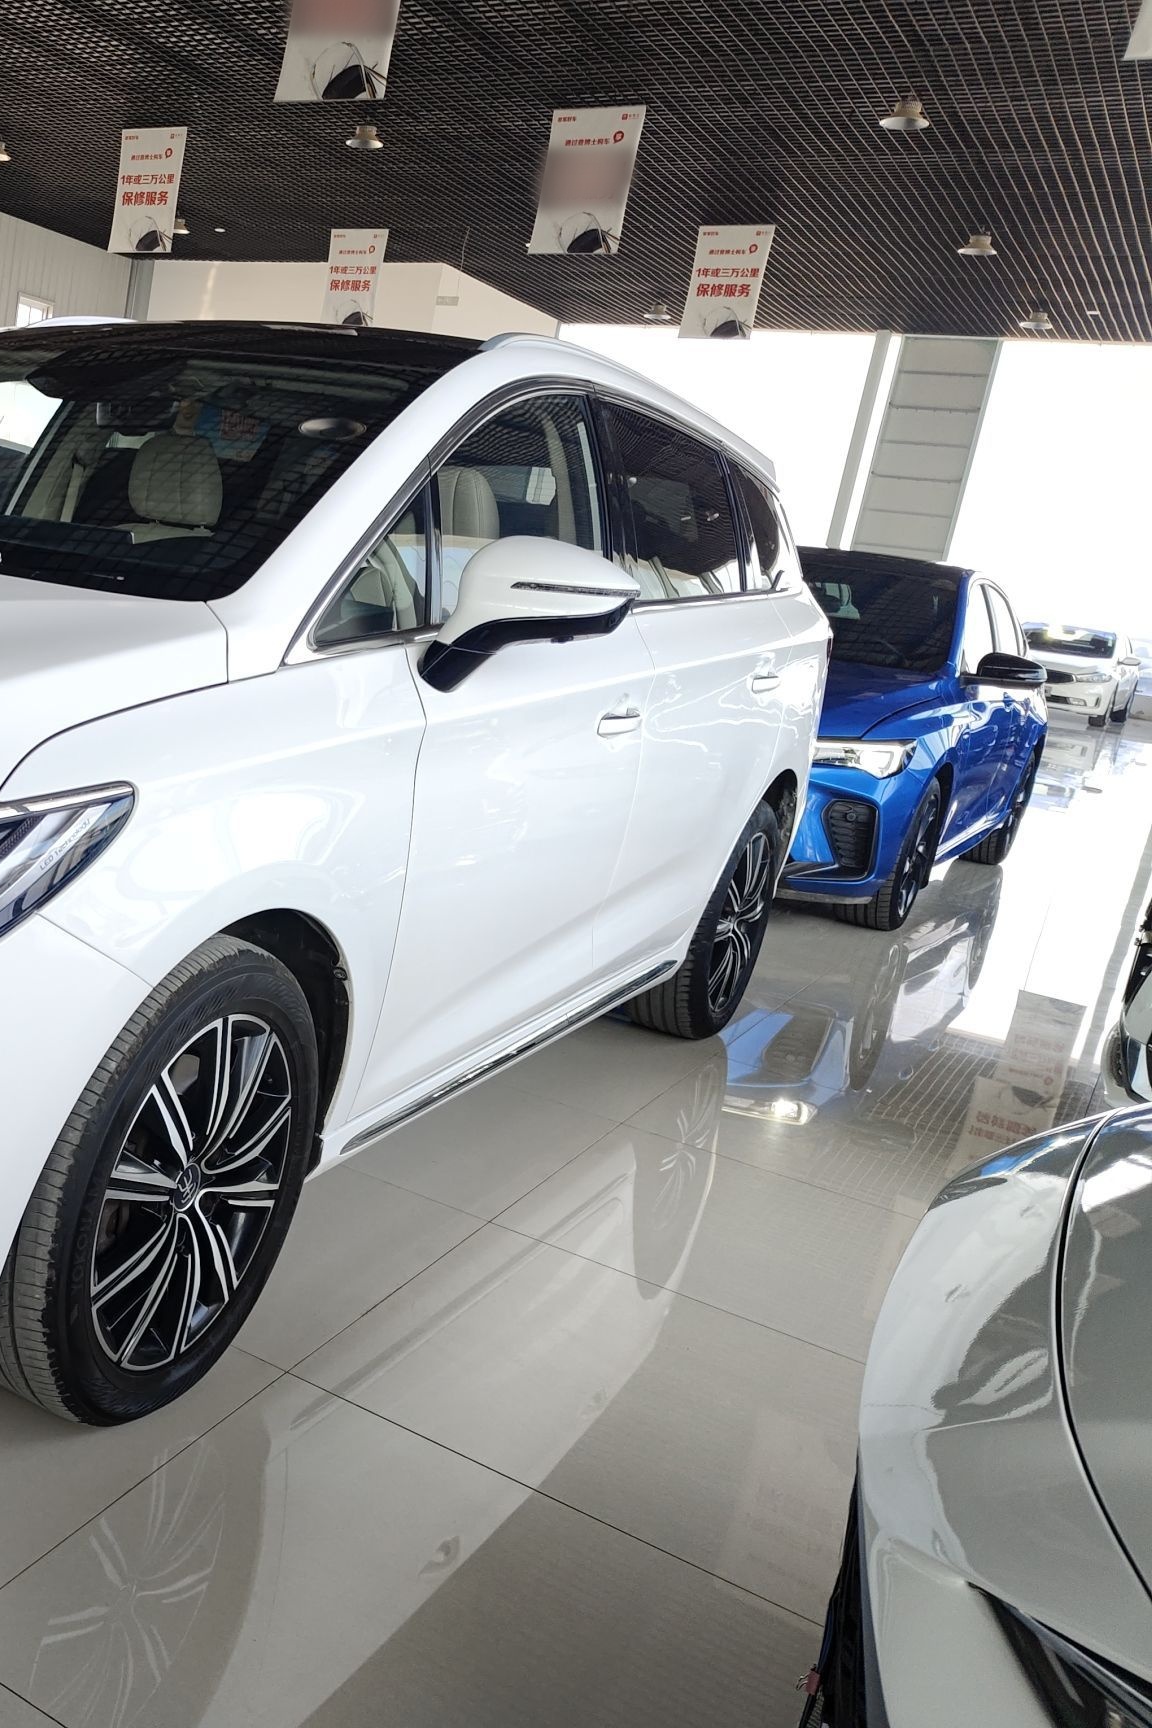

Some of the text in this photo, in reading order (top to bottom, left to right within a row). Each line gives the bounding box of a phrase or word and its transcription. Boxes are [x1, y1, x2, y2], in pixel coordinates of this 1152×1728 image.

[120, 173, 175, 185] 1年或三万公里
[122, 191, 169, 206] 保修服务
[329, 266, 377, 275] 1年或三万公里
[695, 267, 760, 278] 1年或三万公里
[330, 279, 371, 291] 保修服务
[696, 283, 751, 297] 保修服务
[39, 854, 54, 871] LED
